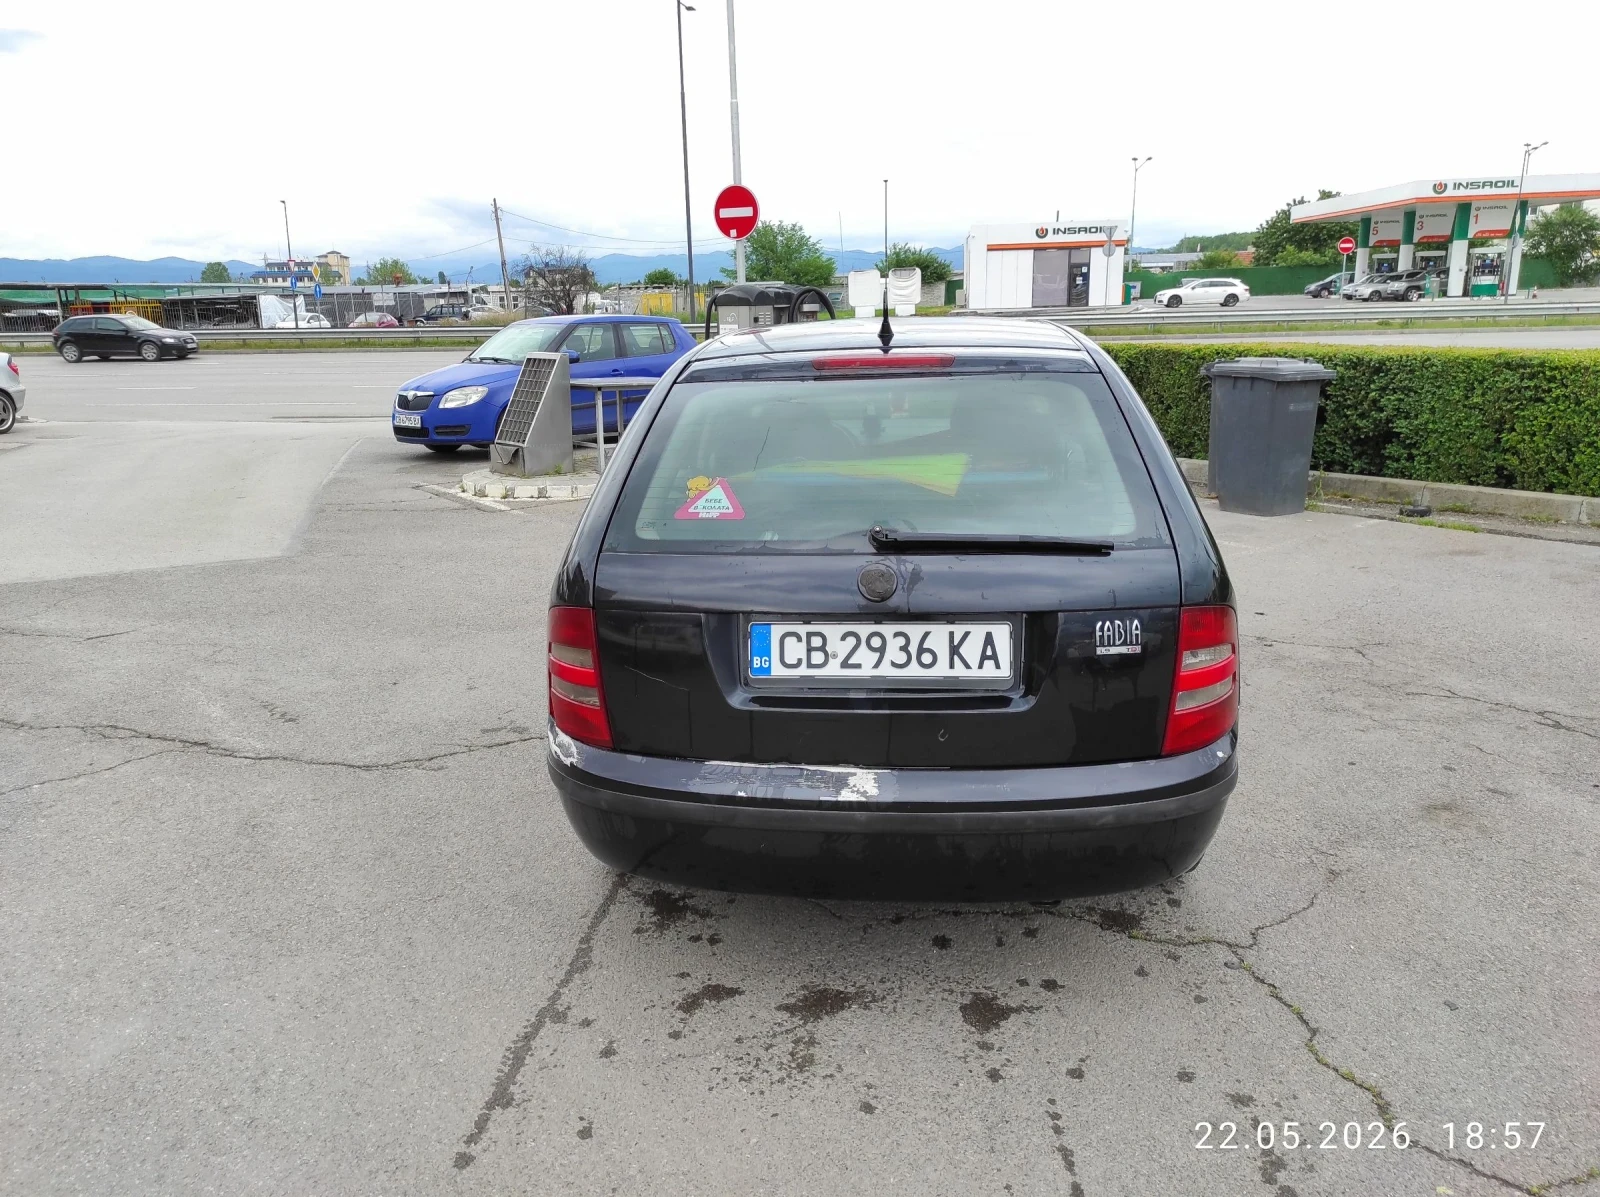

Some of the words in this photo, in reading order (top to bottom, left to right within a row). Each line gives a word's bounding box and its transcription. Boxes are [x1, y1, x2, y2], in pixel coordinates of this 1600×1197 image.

[1452, 180, 1519, 191] INSAOIL
[1473, 213, 1479, 225] 1
[1053, 226, 1109, 236] INSAOI
[1372, 226, 1379, 236] 5
[1416, 220, 1424, 231] 3
[1096, 619, 1141, 646] FABIA
[753, 657, 770, 668] BG
[779, 631, 829, 669] CB
[840, 631, 938, 669] 2936
[949, 631, 1001, 669] KA
